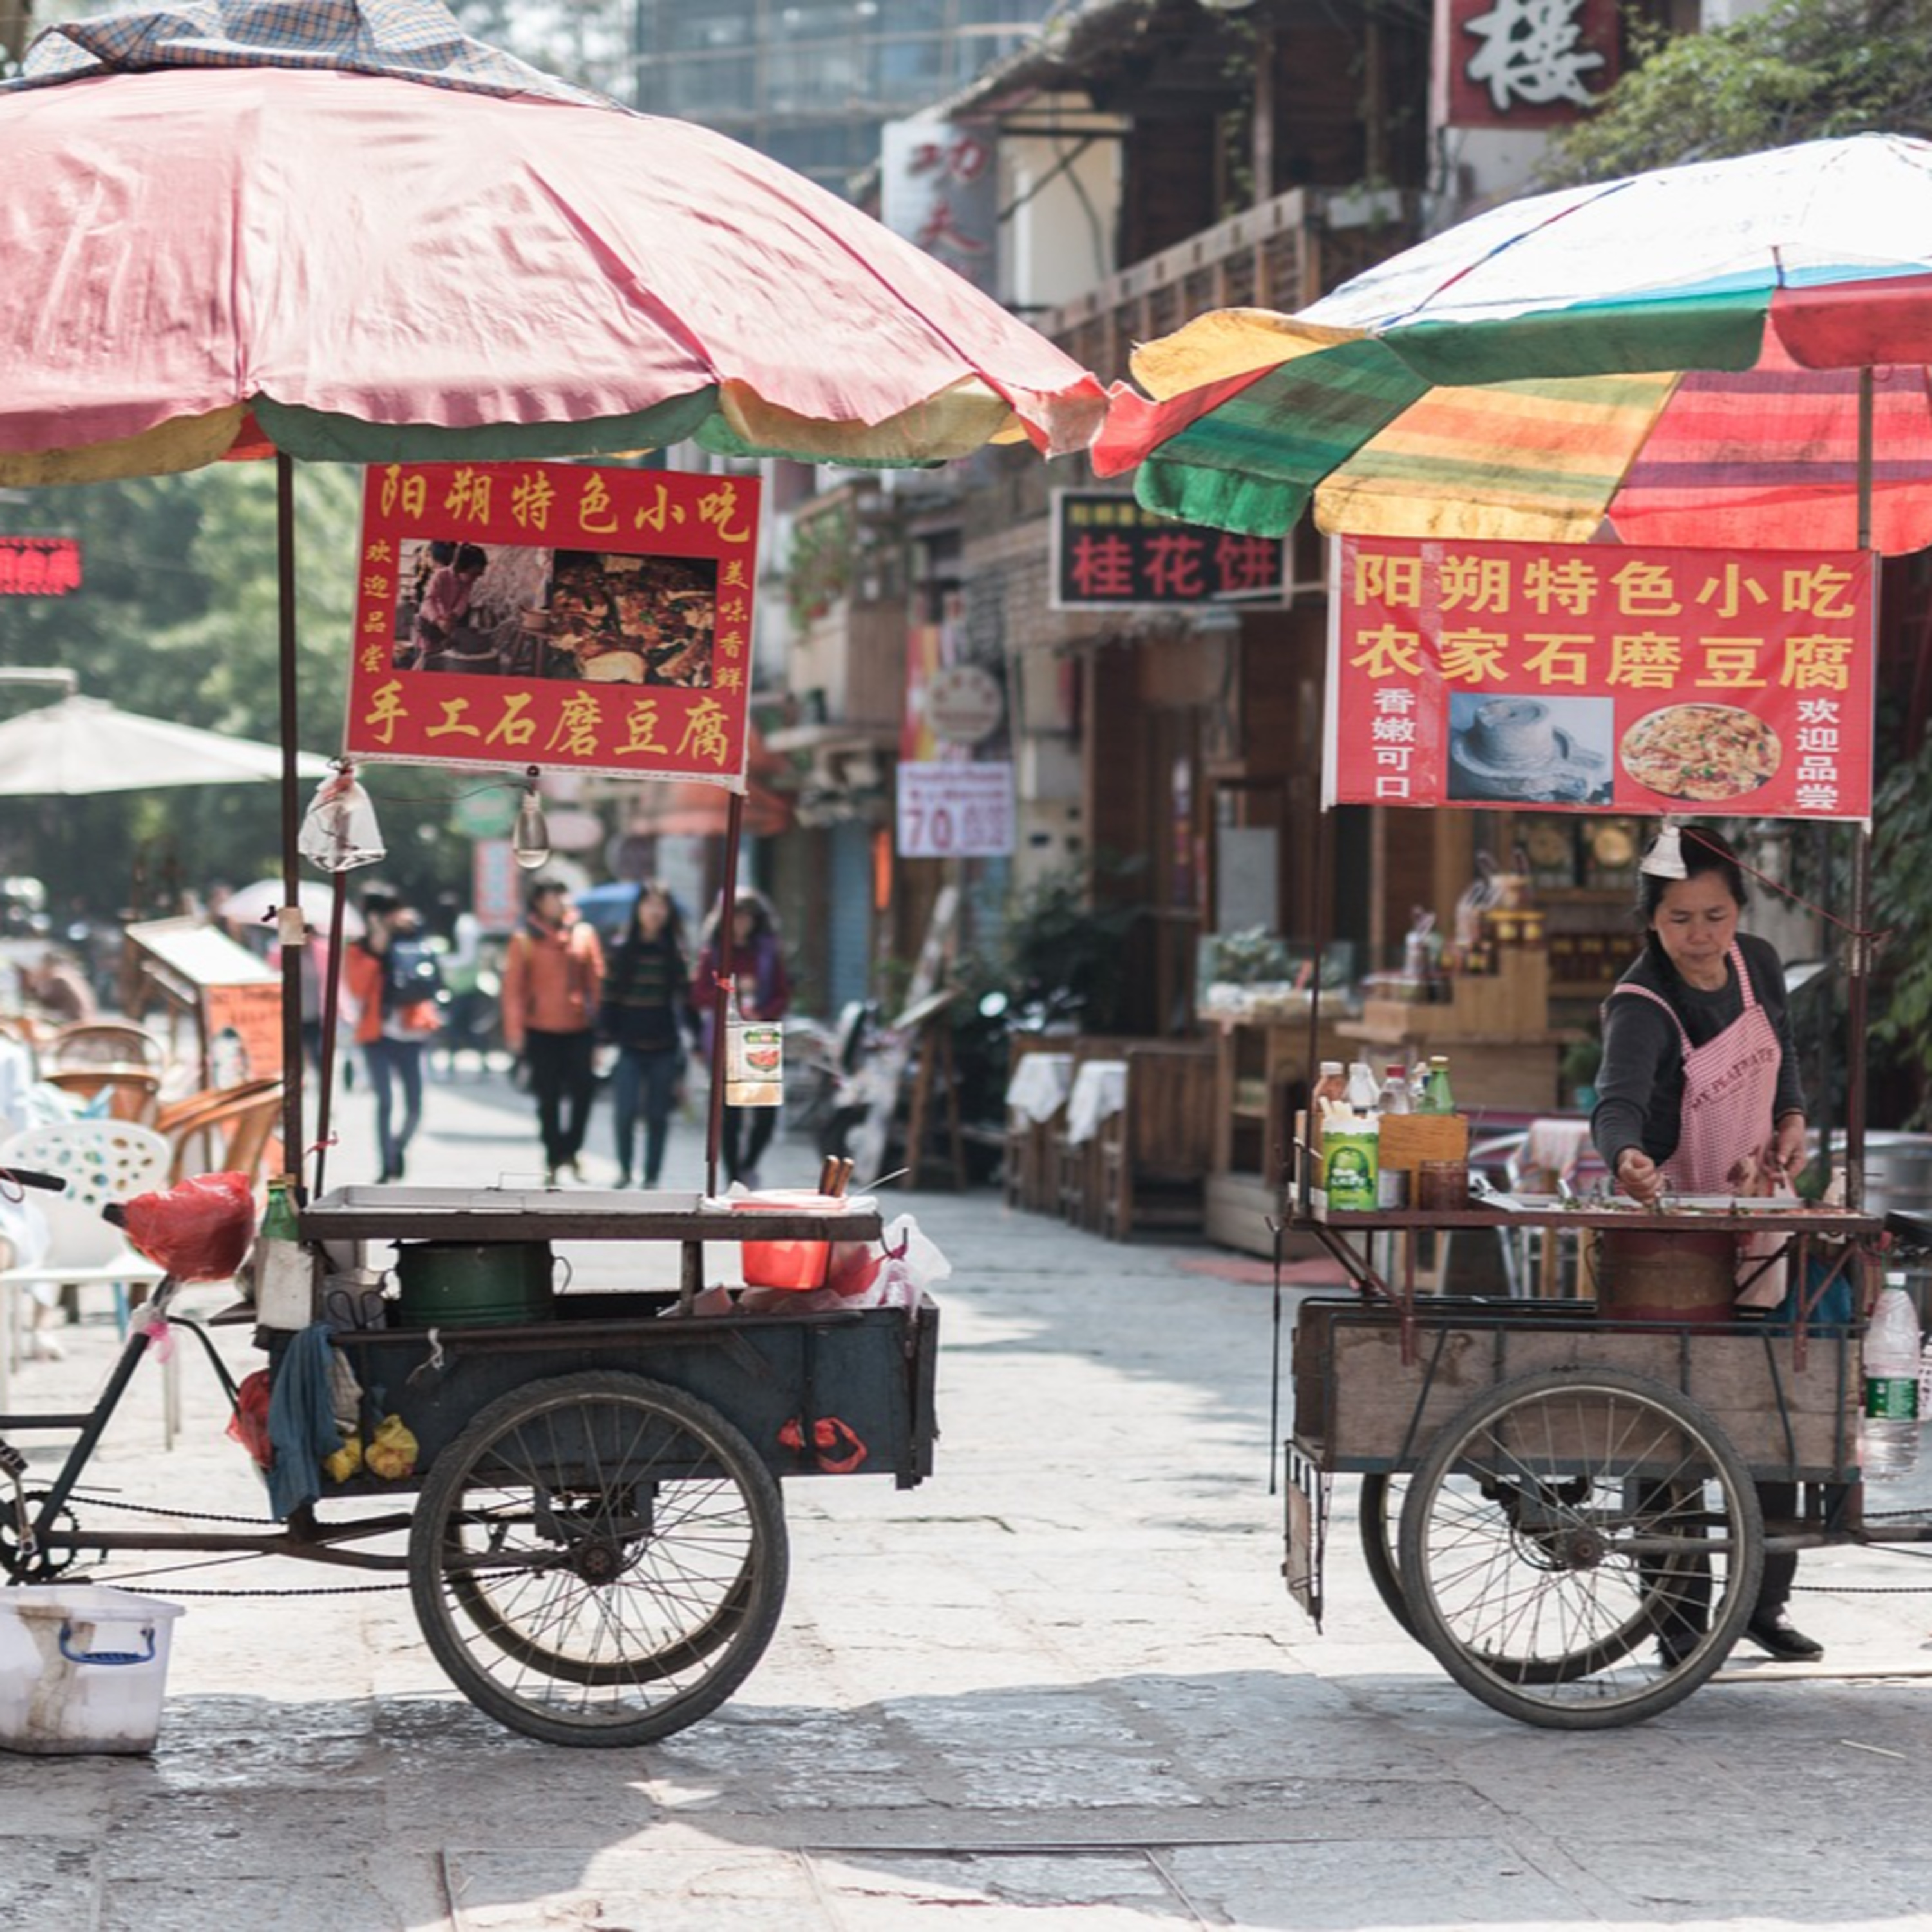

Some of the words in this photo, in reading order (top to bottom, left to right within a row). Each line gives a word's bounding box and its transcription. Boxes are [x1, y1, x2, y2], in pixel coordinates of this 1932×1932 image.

[906, 138, 992, 279] 功夫
[381, 463, 750, 542] 阳朔特色小吃
[359, 538, 392, 673] 欢迎品尝
[1072, 534, 1276, 596] 桂花饼
[1354, 553, 1857, 619] 阳朔特色小吃
[713, 559, 750, 696] 美味香鲜
[1350, 623, 1854, 690] 农家石磨豆腐
[365, 679, 730, 766] 手工石磨豆腐
[1371, 688, 1416, 798] 香嫩可口
[1795, 698, 1841, 810] 欢迎品尝
